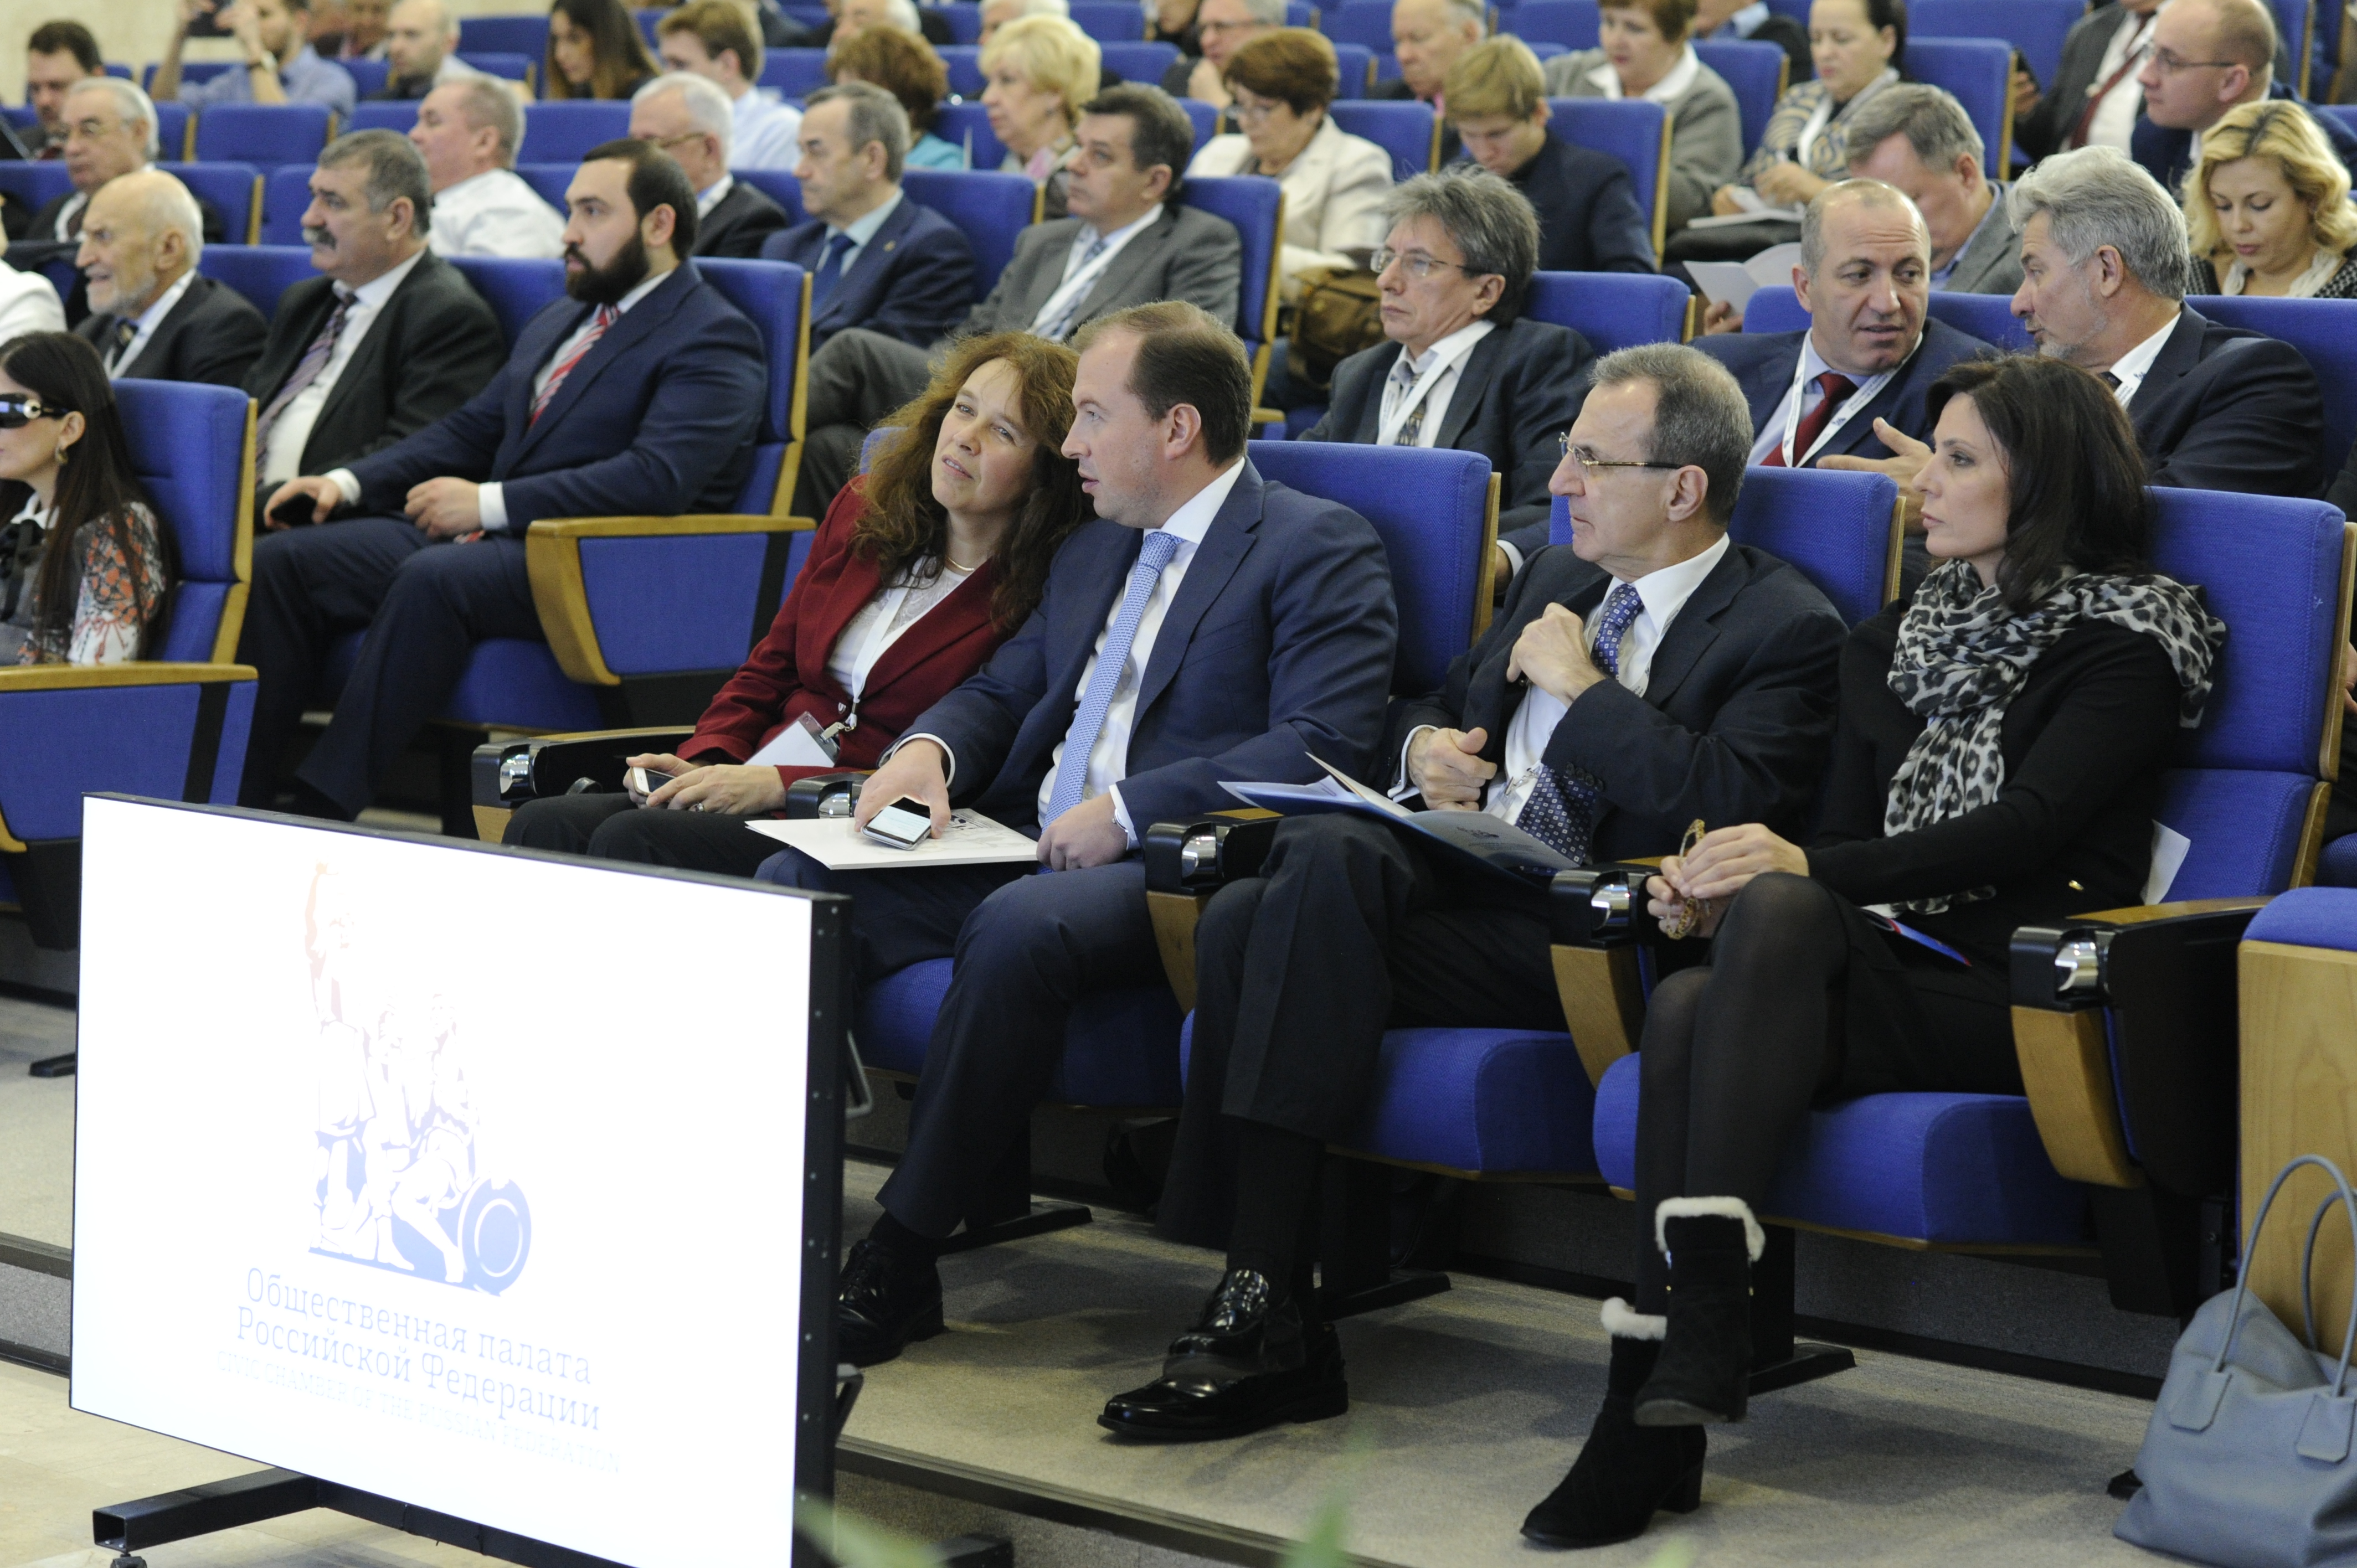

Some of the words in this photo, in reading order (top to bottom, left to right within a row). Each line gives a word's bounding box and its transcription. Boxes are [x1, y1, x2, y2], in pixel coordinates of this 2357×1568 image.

[237, 1306, 411, 1383] Российской
[421, 1352, 600, 1431] Федерации
[248, 1267, 467, 1353] Общественная
[478, 1333, 591, 1385] палата
[217, 1351, 260, 1380] CIVIC
[265, 1363, 348, 1404] CHAMBER
[353, 1385, 374, 1410] OF
[380, 1392, 413, 1420] THE
[419, 1402, 495, 1441] RUSSIAN
[502, 1425, 621, 1473] FEDERATION
